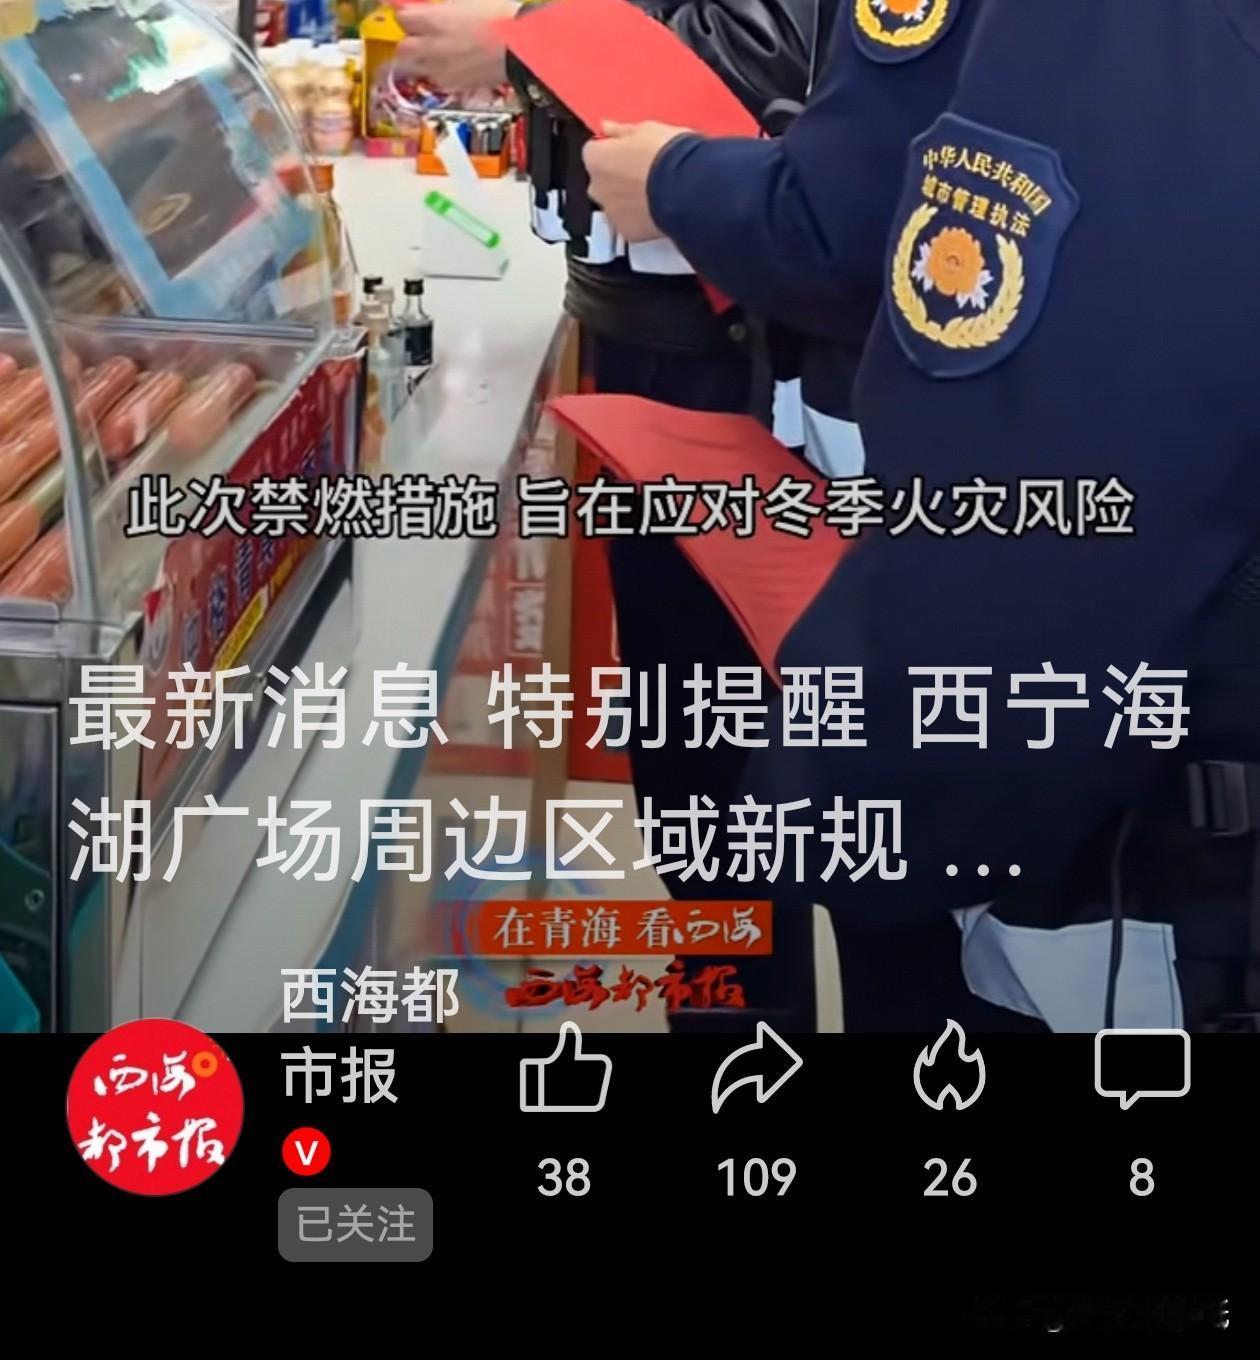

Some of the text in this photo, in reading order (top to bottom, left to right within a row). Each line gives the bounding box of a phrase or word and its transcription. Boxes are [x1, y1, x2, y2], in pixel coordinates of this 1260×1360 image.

[920, 173, 1032, 238] 城市管理执法
[922, 144, 1053, 217] 中华人民共和国
